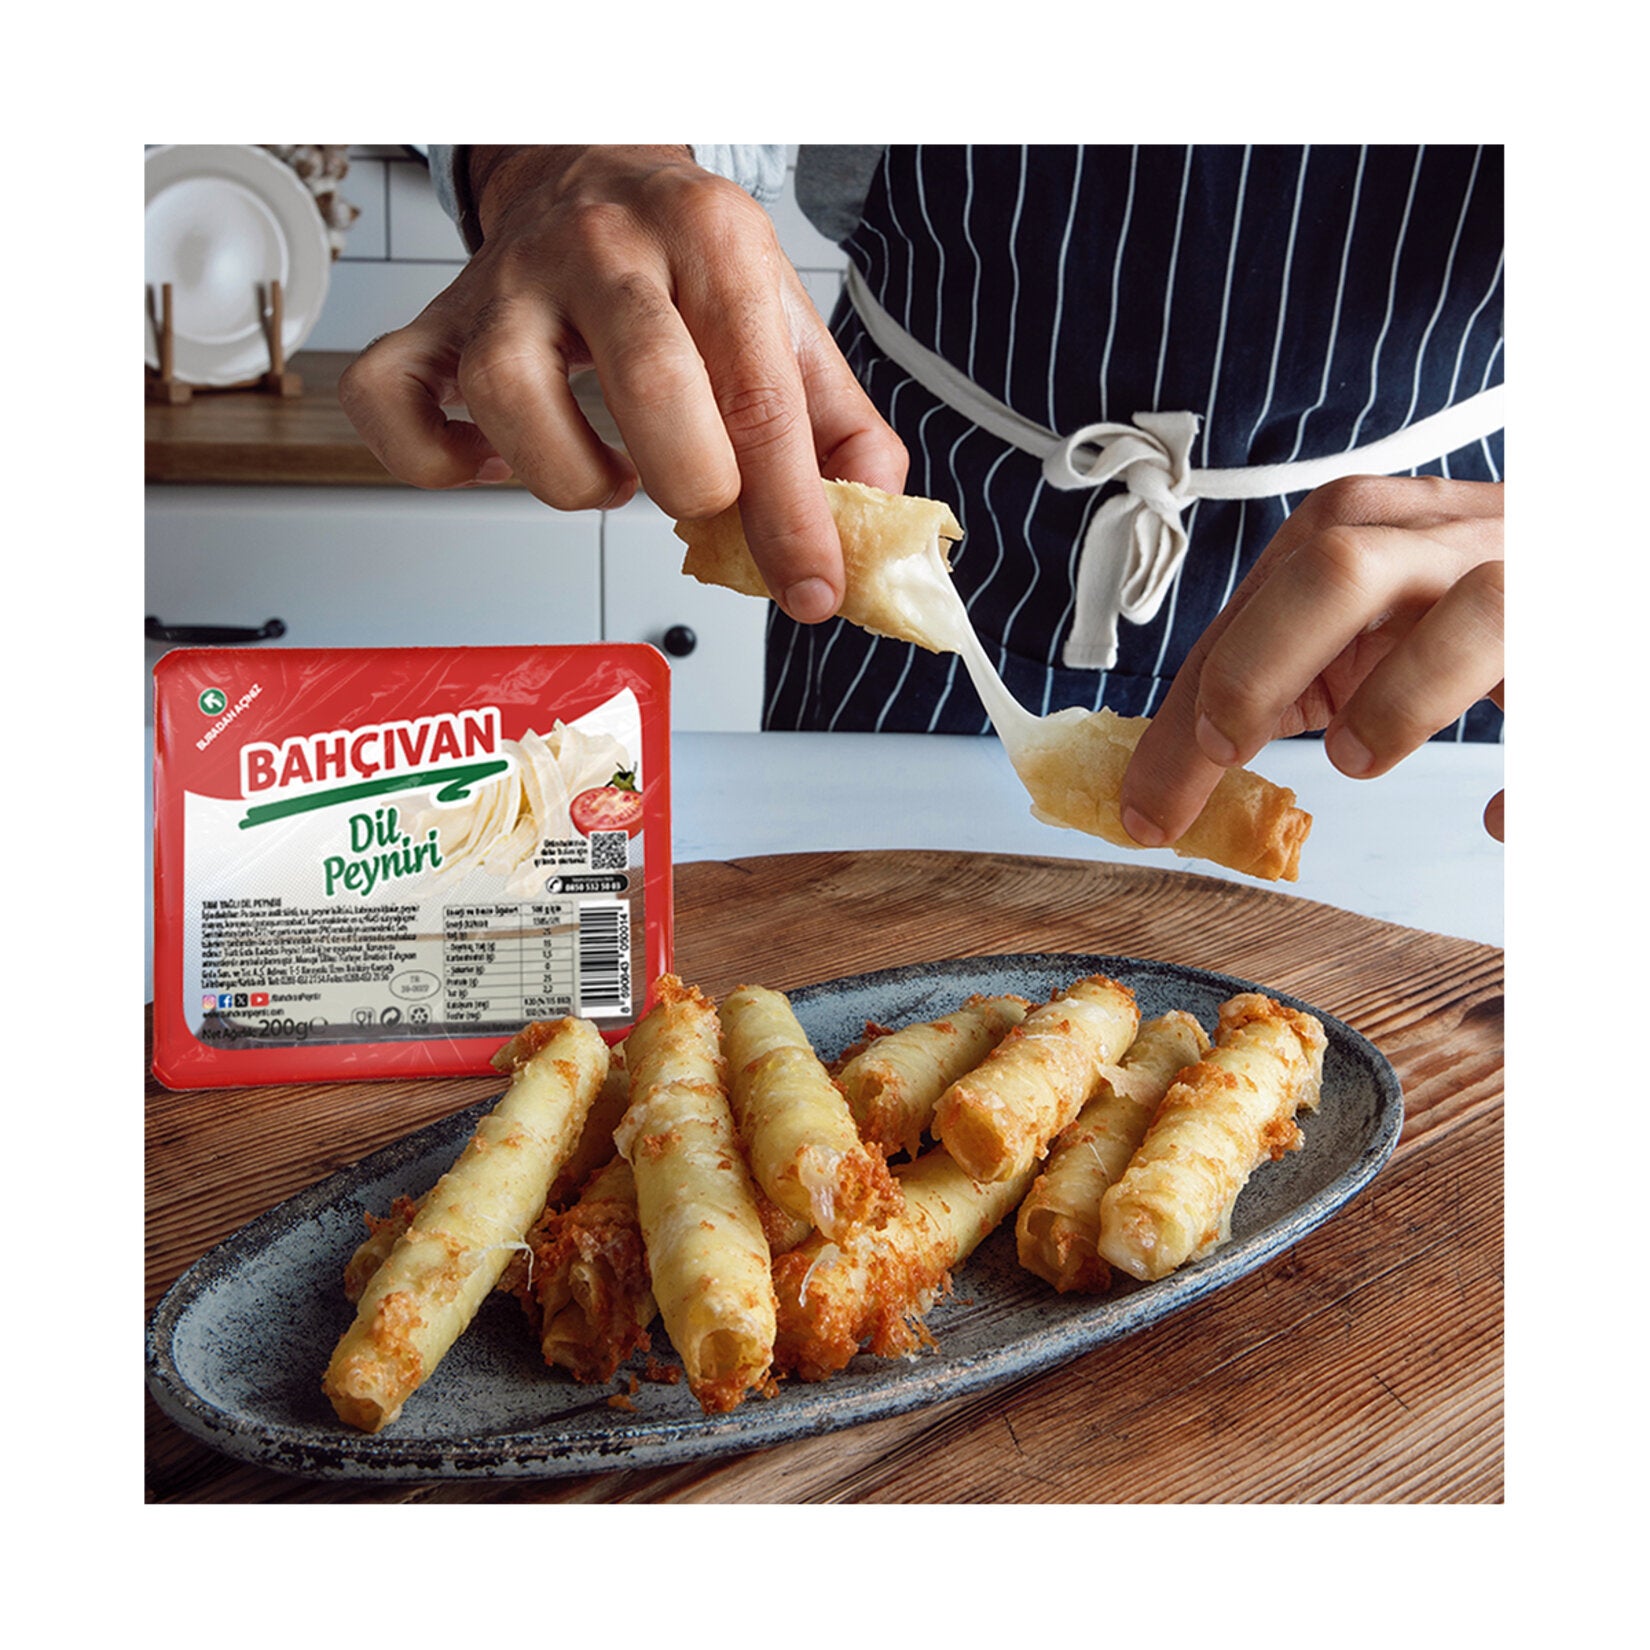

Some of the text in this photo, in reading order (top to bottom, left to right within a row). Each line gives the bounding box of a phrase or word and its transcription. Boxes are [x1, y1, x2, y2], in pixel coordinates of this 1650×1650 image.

[247, 713, 495, 793] BAHÇIVAN
[349, 807, 401, 853] Dil
[323, 830, 443, 897] Peyniri
[259, 1018, 308, 1040] 200g
